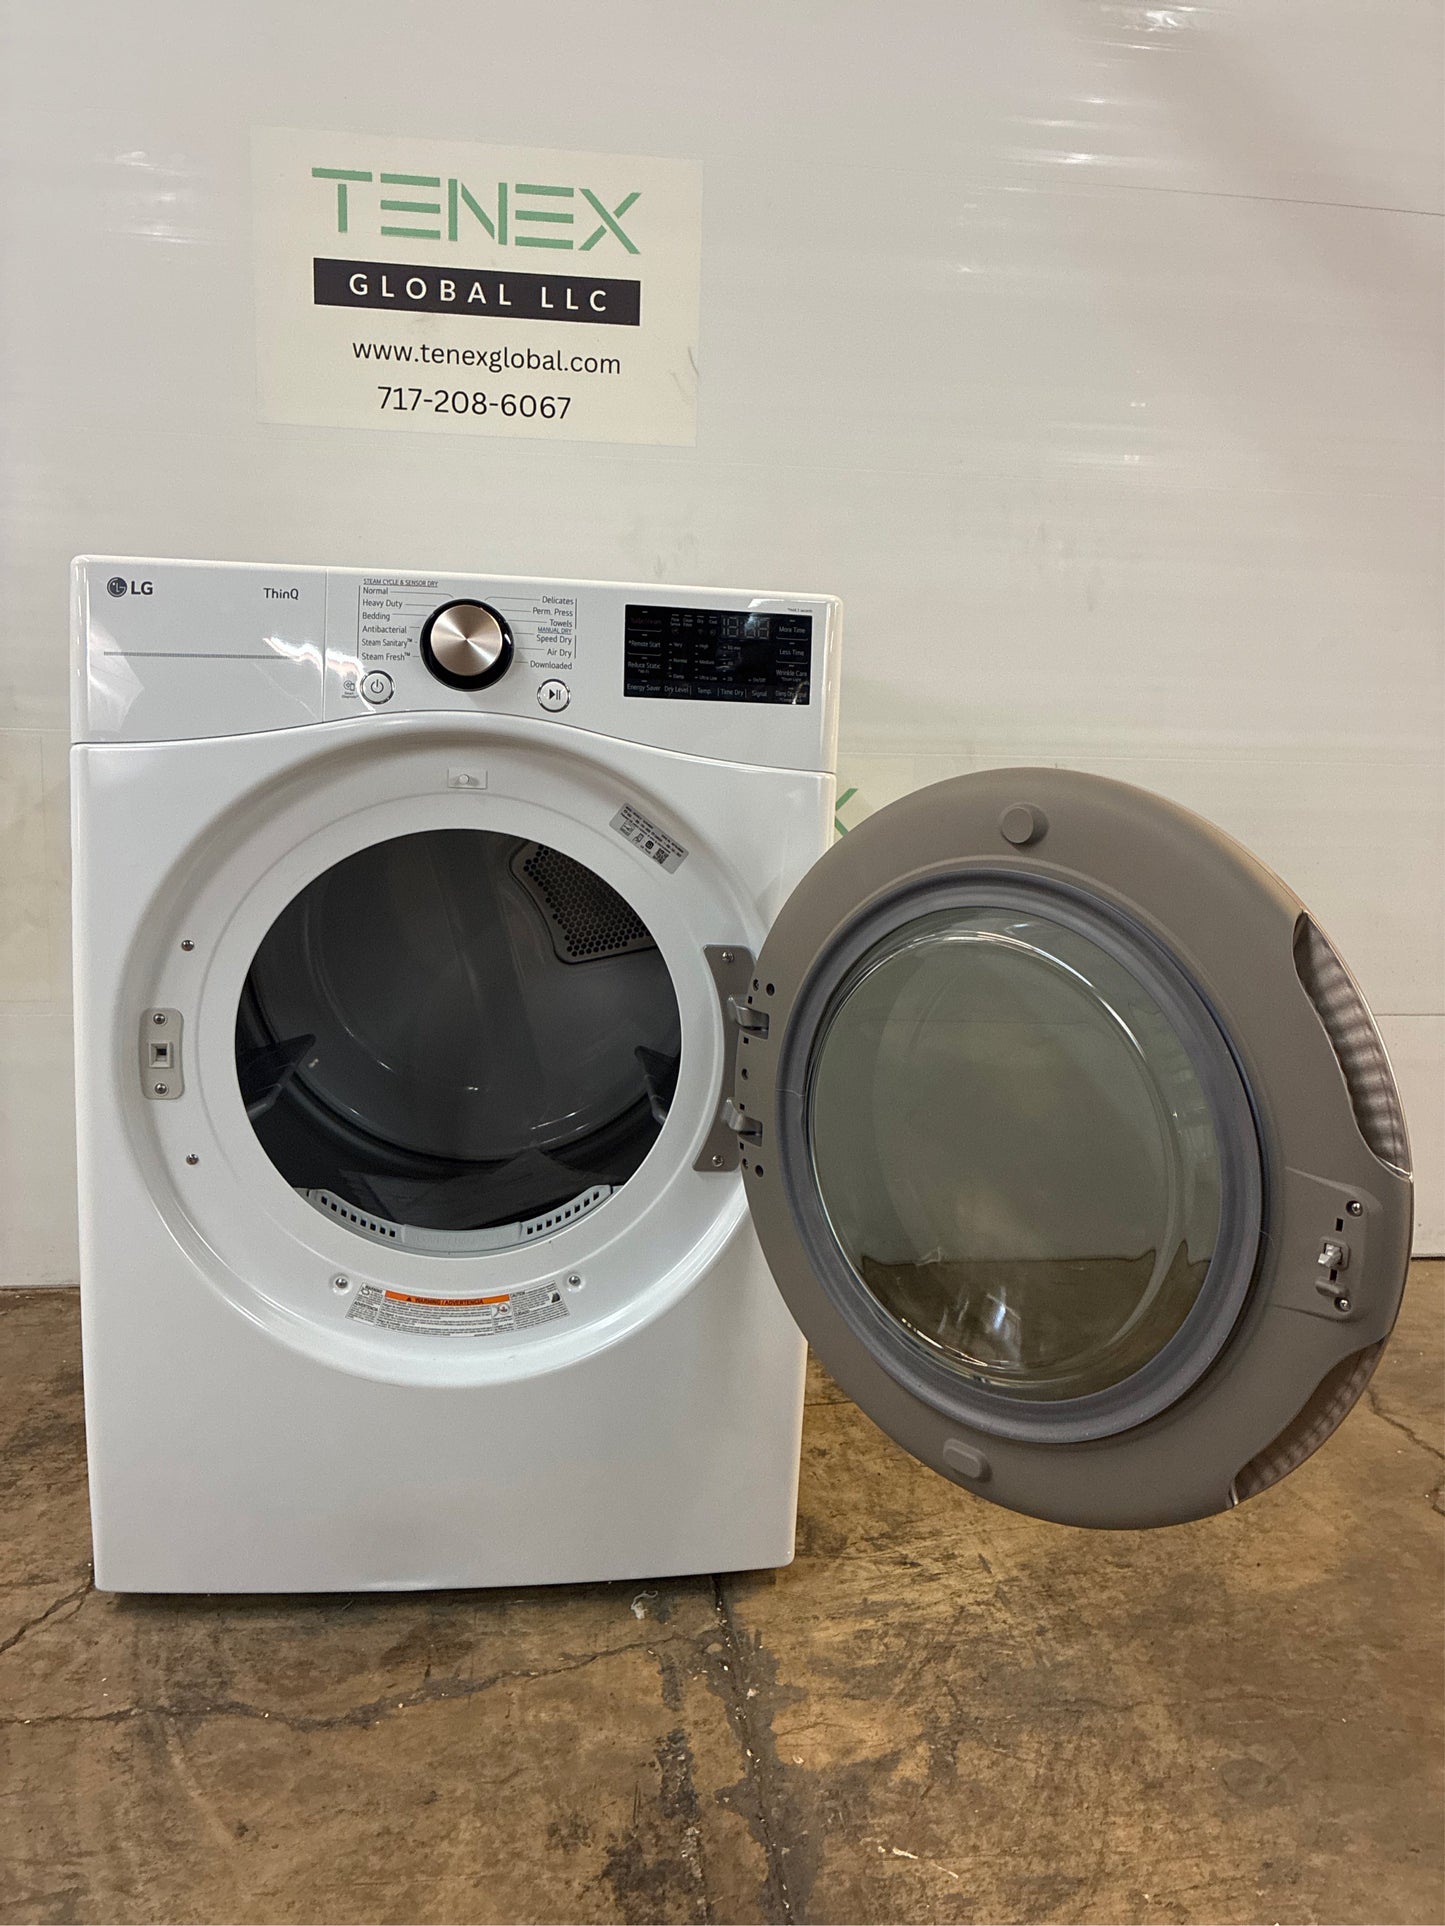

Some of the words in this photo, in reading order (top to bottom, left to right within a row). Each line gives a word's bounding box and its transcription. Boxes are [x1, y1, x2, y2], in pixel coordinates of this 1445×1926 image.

[312, 167, 642, 254] TENEX
[349, 273, 512, 306] GLOBAL
[541, 286, 608, 312] LLC
[352, 341, 621, 374] www.tenexglobal.com
[377, 386, 571, 420] 717-208-6067
[131, 581, 153, 595] LG
[263, 588, 299, 600] ThinQ
[362, 599, 384, 608] Heavy
[386, 600, 402, 609] Duty
[542, 596, 574, 605] Delicates
[533, 607, 552, 615] Perm.
[554, 608, 573, 616] Press
[362, 612, 390, 622] Bedding
[550, 619, 572, 627] Towels
[537, 634, 557, 644] Speed
[560, 636, 572, 645] Dry
[362, 652, 384, 660] Steam
[547, 648, 557, 656] Air
[560, 649, 572, 658] Dry
[530, 660, 572, 670] Downloaded
[415, 1297, 440, 1306] WARNING
